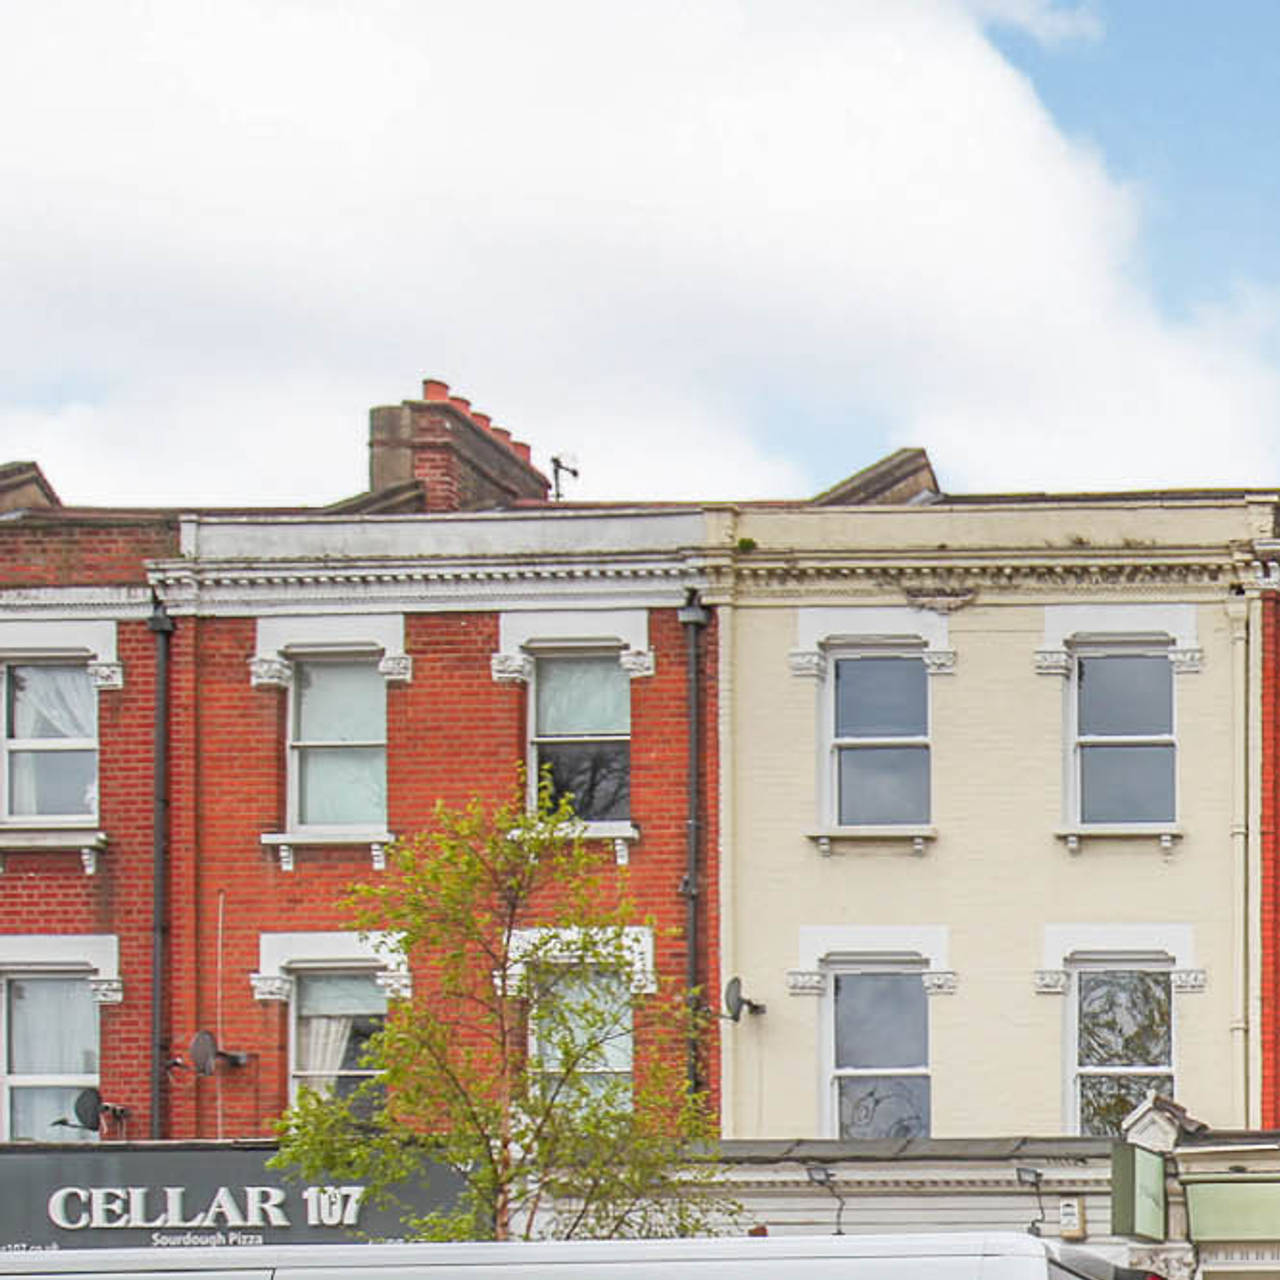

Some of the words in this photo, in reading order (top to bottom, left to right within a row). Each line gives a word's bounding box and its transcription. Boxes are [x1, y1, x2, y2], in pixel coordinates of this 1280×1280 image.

[48, 1186, 291, 1229] CELLAR
[302, 1186, 366, 1225] 107
[152, 1231, 226, 1248] Sourdough
[228, 1231, 264, 1246] Pizza
